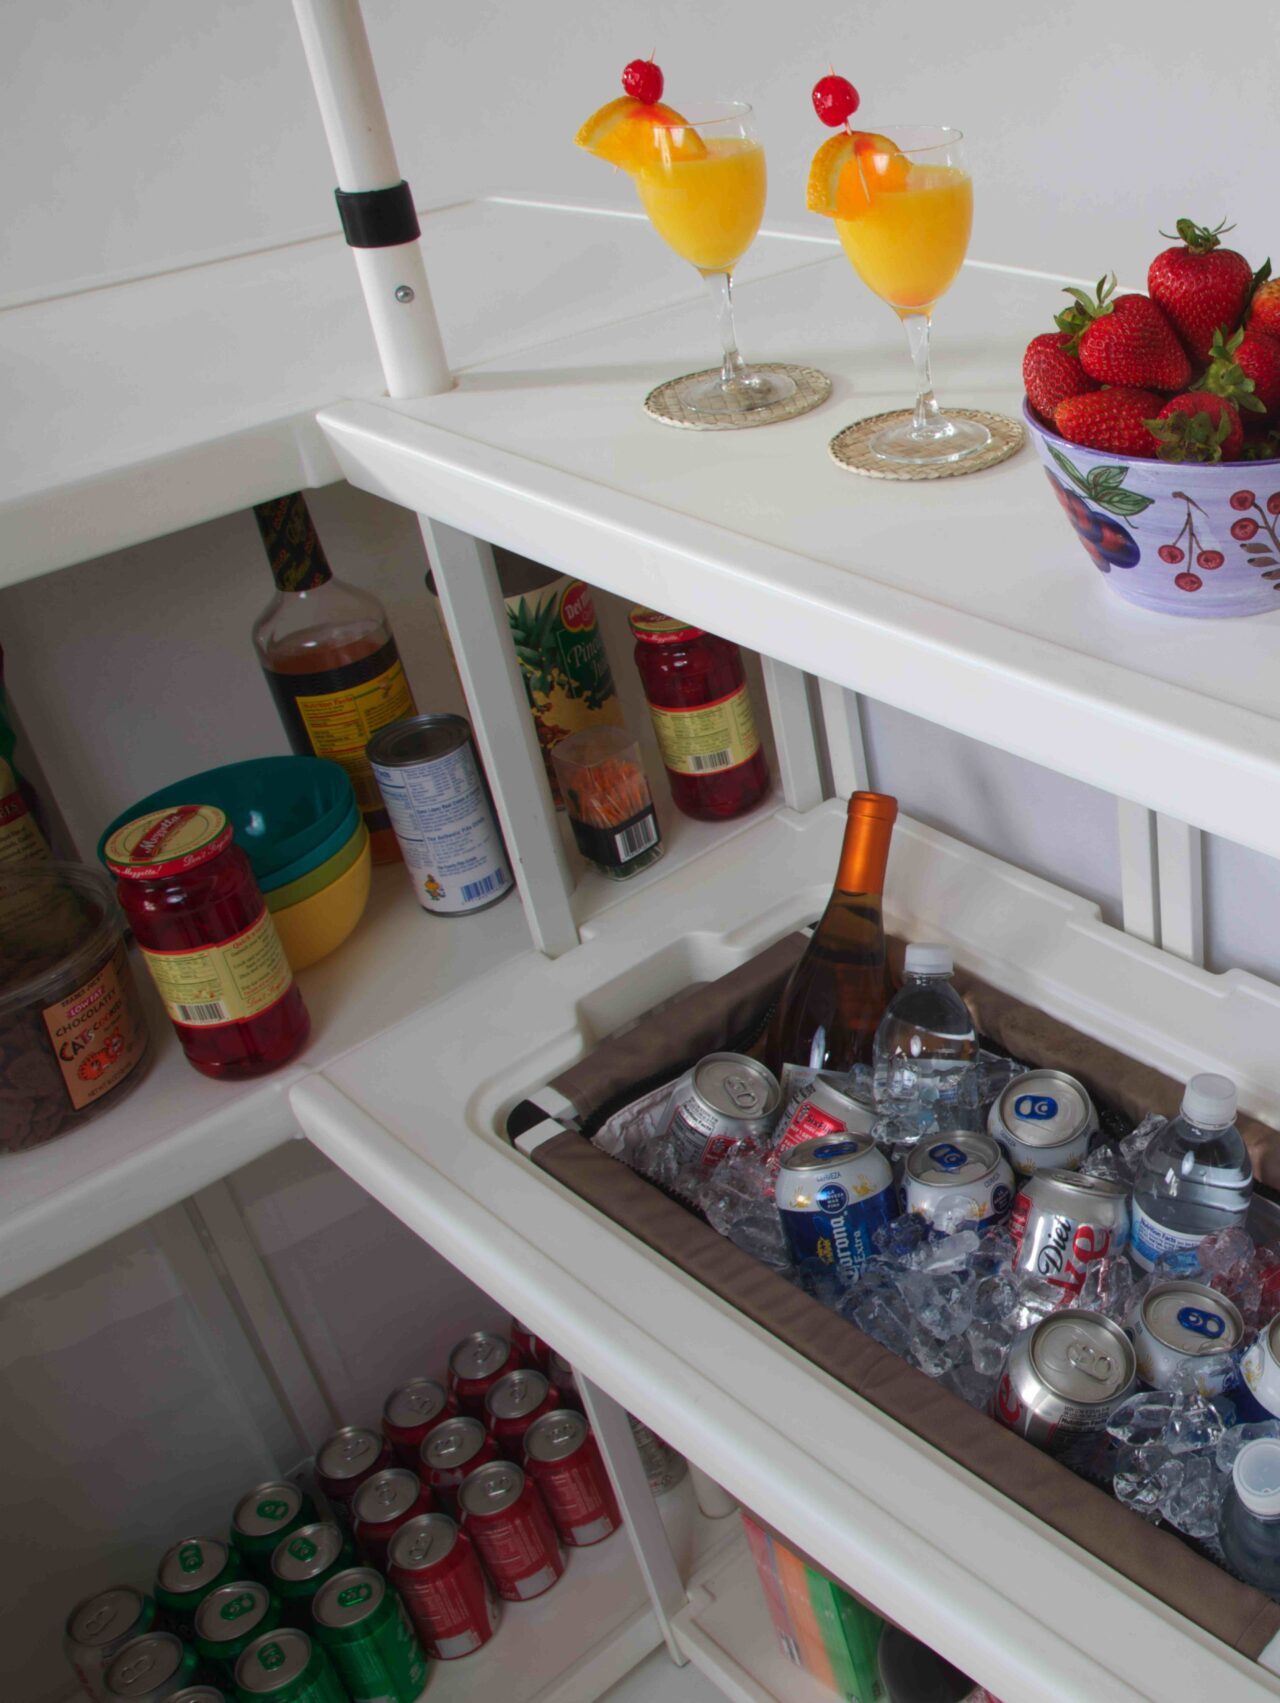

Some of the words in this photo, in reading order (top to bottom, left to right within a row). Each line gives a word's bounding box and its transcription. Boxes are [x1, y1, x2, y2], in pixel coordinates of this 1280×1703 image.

[564, 599, 582, 620] Del
[140, 813, 181, 855] Mezzetta
[123, 865, 162, 879] Mezzetta!
[70, 999, 89, 1016] LOW
[1038, 1214, 1072, 1276] Diet
[1161, 1232, 1177, 1244] Facts
[853, 1230, 867, 1268] Extra
